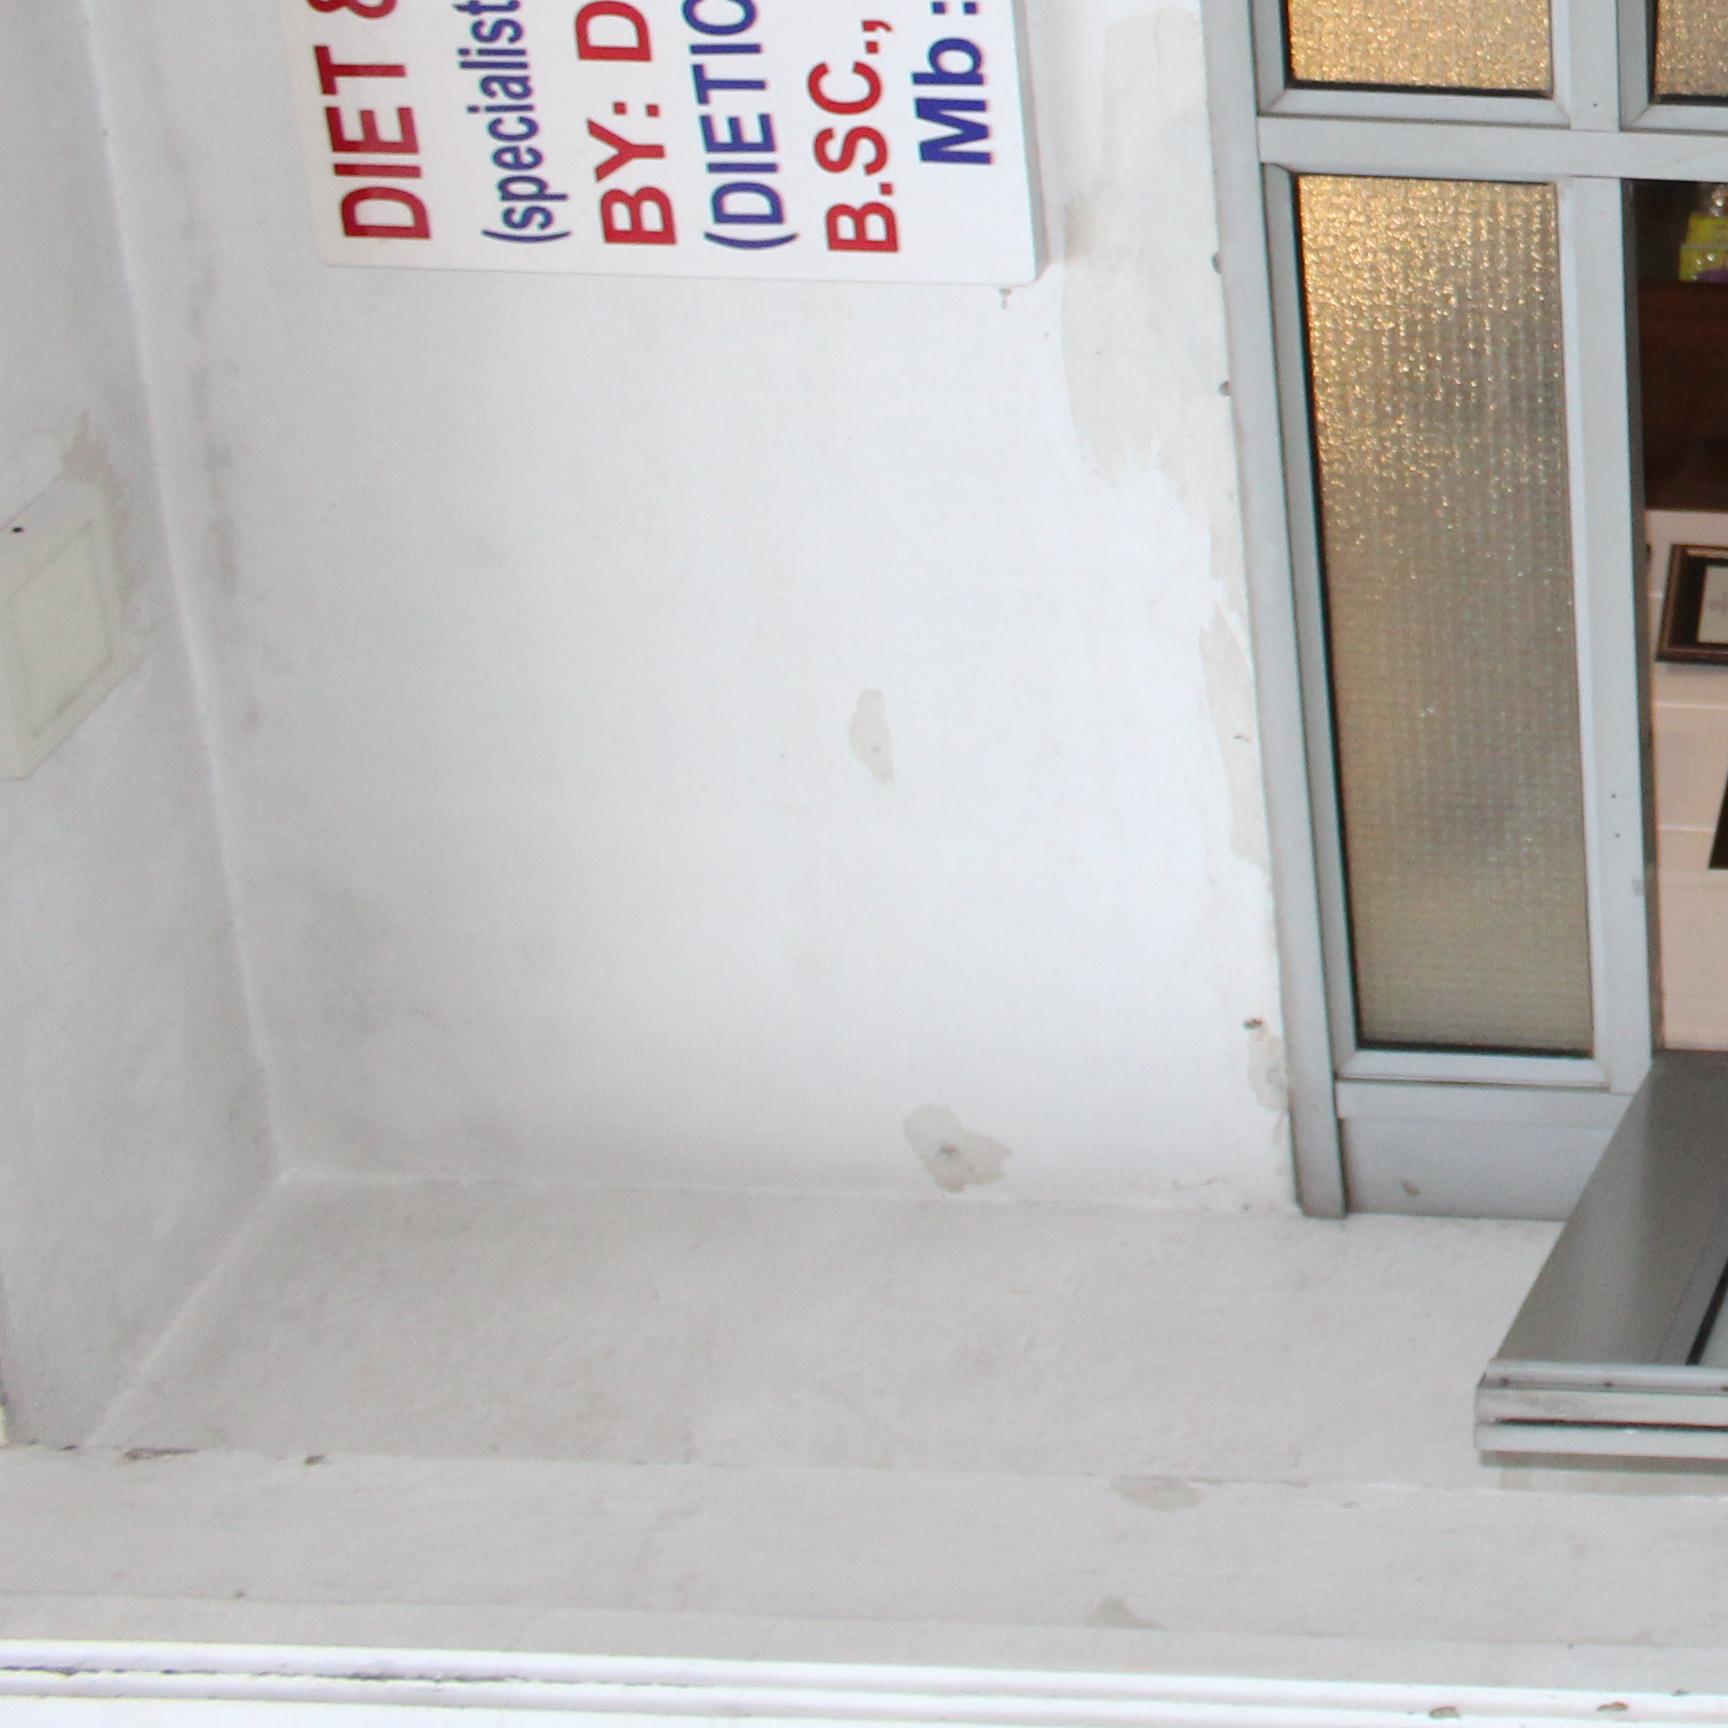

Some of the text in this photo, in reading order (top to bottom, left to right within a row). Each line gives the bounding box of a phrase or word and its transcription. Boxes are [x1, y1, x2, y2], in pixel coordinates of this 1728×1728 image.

[314, 44, 433, 241] DIET
[587, 98, 679, 247] BY:
[808, 18, 902, 254] B.SC.,
